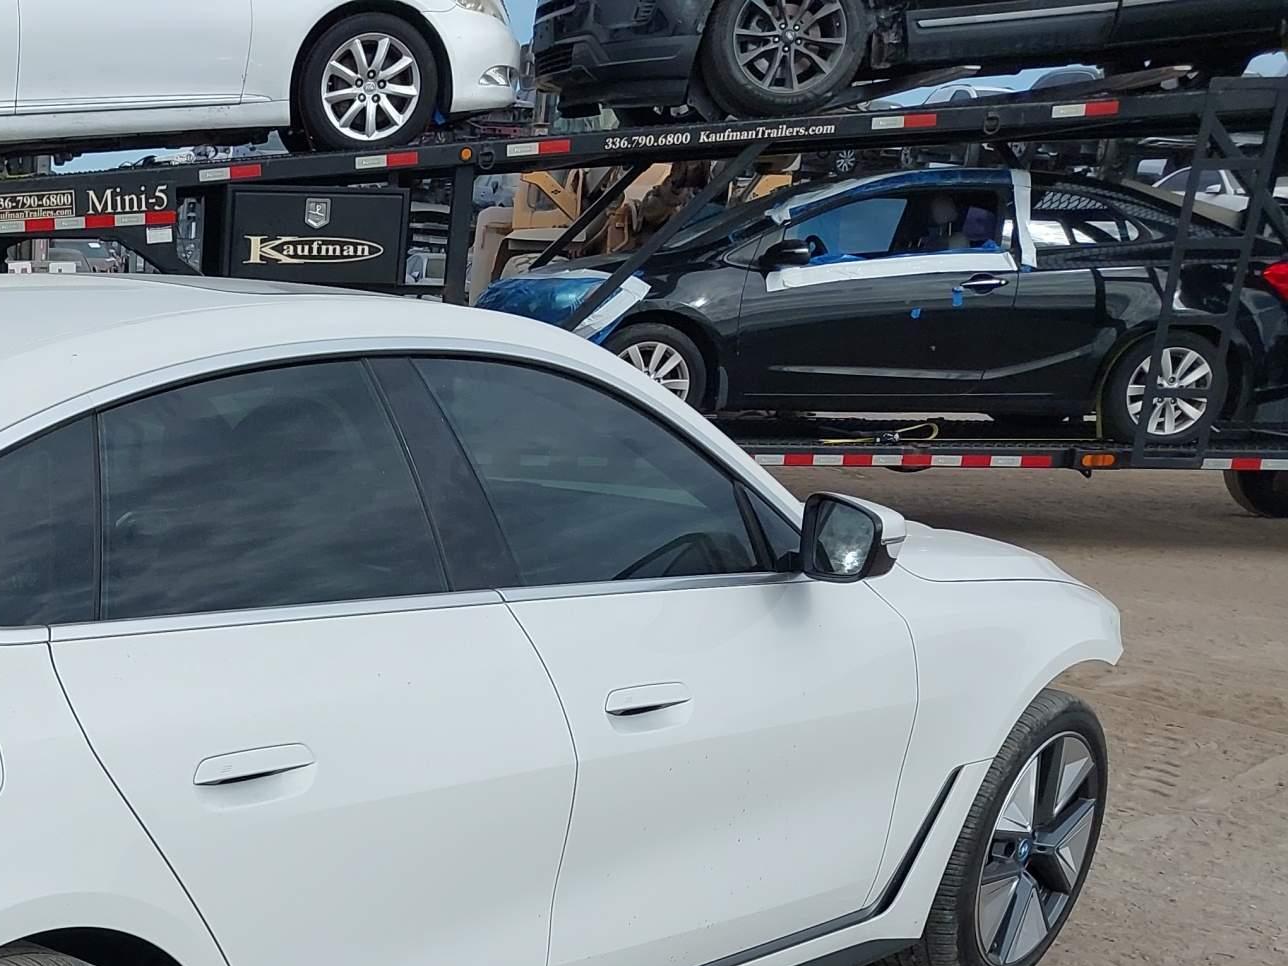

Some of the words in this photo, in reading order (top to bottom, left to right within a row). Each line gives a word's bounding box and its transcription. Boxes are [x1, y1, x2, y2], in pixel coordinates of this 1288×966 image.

[604, 131, 691, 150] 336.790.6800
[698, 122, 836, 144] KaufmanTrailers.com
[86, 184, 168, 215] Mini-5
[242, 235, 371, 264] Kaufman
